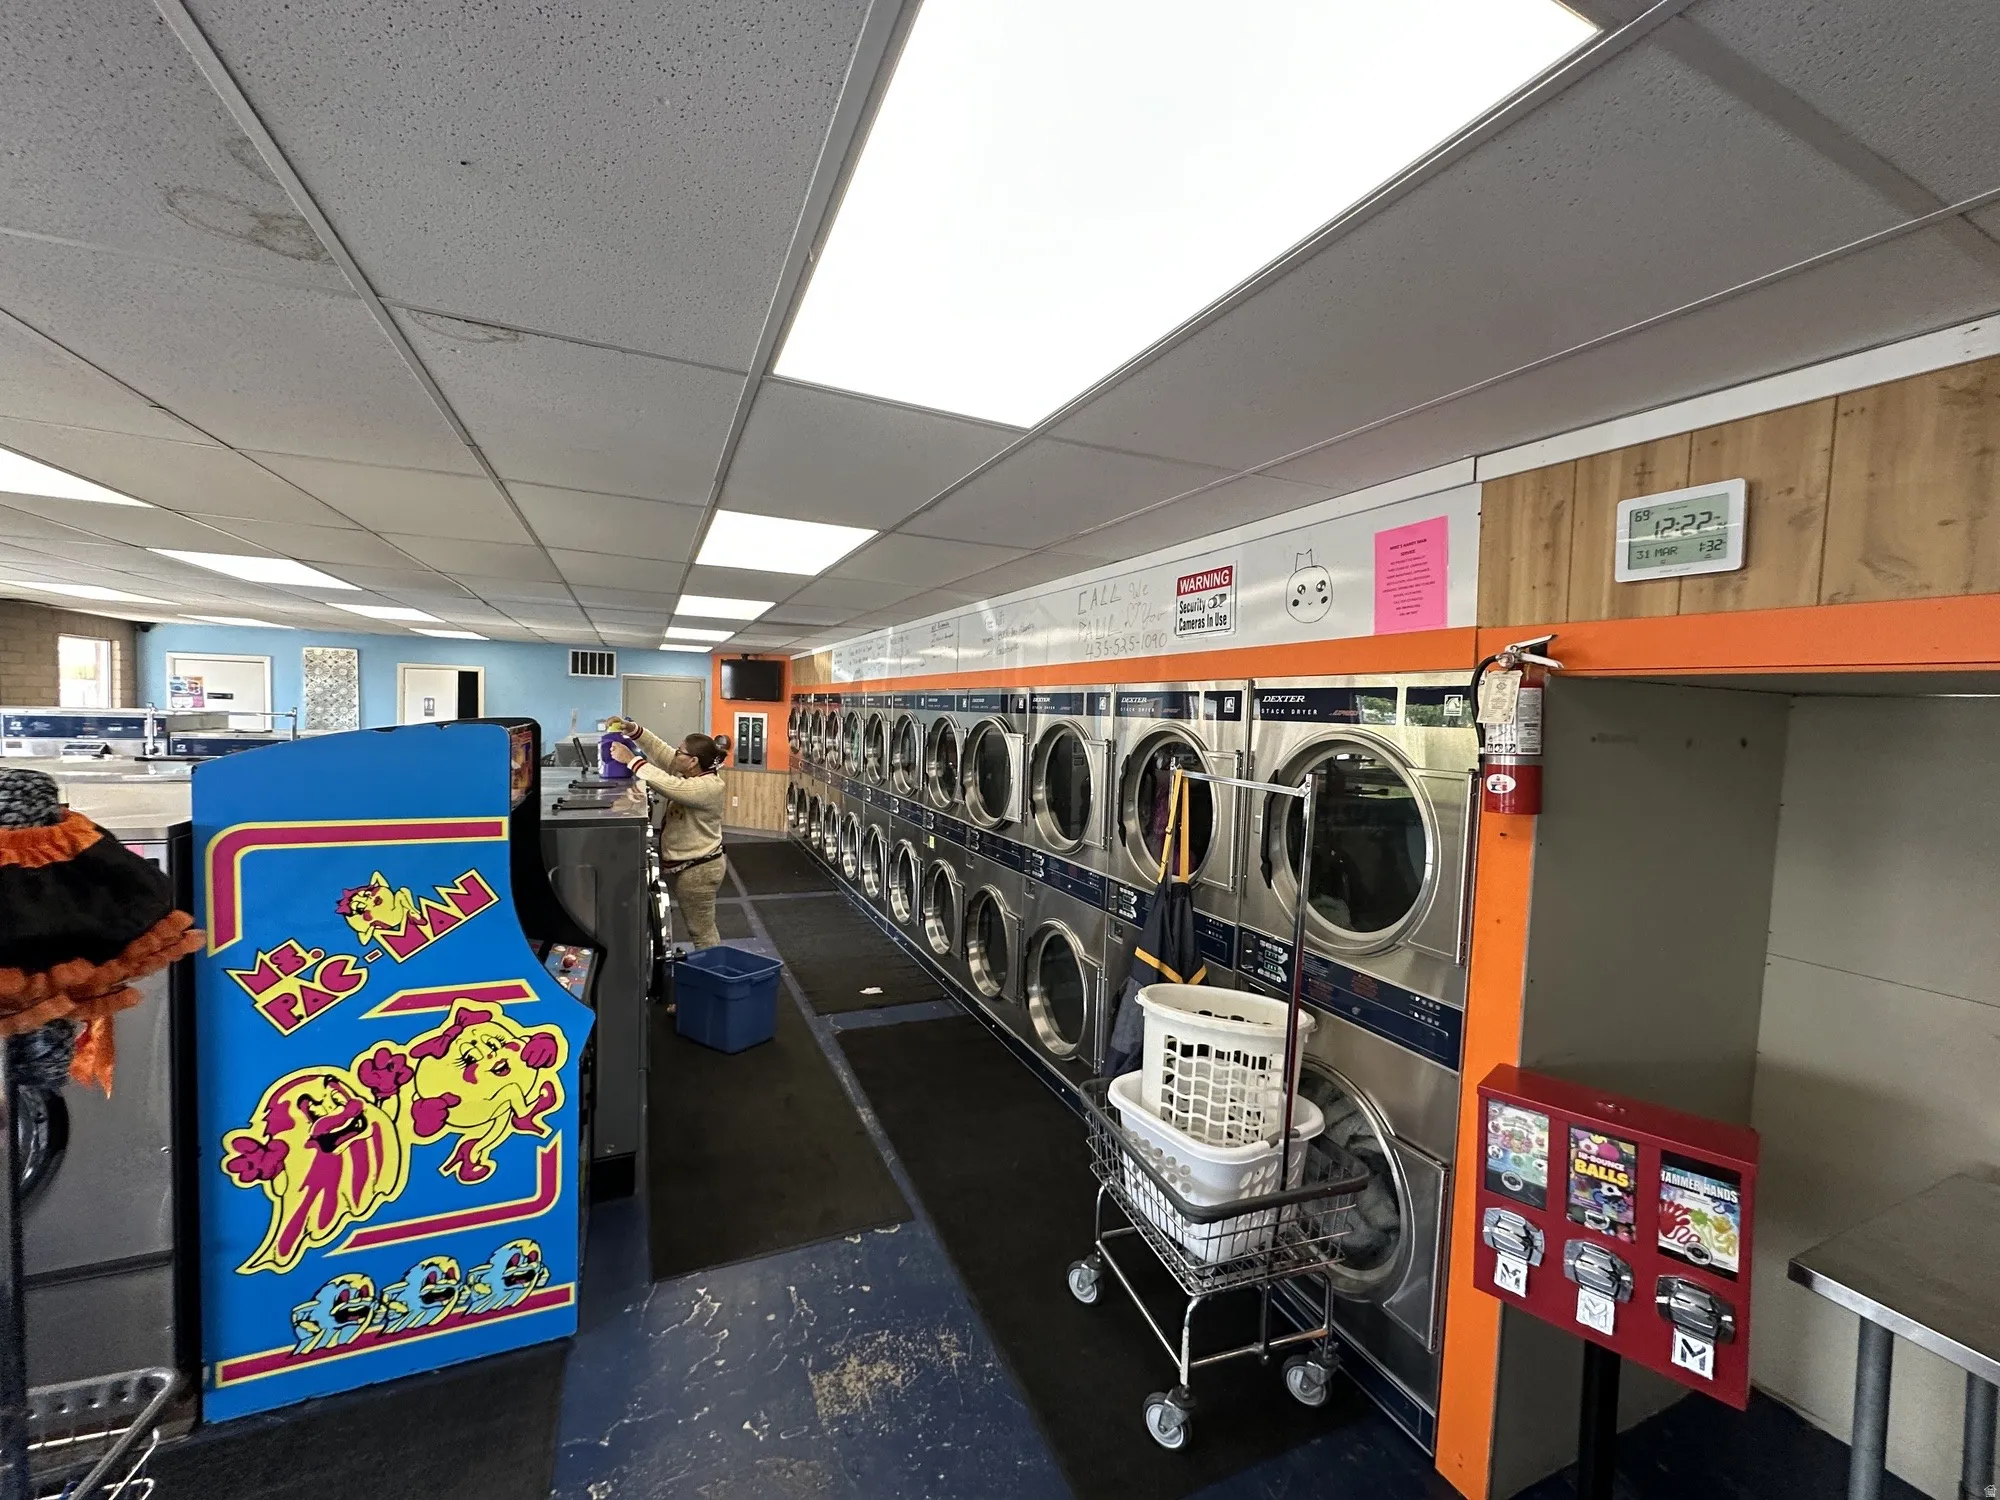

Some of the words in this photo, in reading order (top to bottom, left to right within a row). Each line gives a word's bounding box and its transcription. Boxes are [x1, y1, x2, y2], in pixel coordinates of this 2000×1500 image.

[1654, 510, 1713, 539] 12:22
[1636, 550, 1650, 560] 31
[1654, 546, 1678, 557] MAR
[1699, 538, 1723, 552] 1:32
[1180, 569, 1230, 593] WARNING
[1077, 583, 1122, 615] CALL
[1179, 598, 1206, 615] Security
[1077, 613, 1122, 642] PAUL
[1178, 617, 1206, 631] Cameras
[1206, 613, 1213, 628] In
[1214, 611, 1228, 627] Use
[1262, 695, 1306, 703] DEXTER
[255, 868, 500, 1037] PAC-MAN
[1578, 1151, 1625, 1171] HI-BOUNCE
[1574, 1158, 1629, 1188] BALLS
[1703, 1183, 1739, 1203] HANDS
